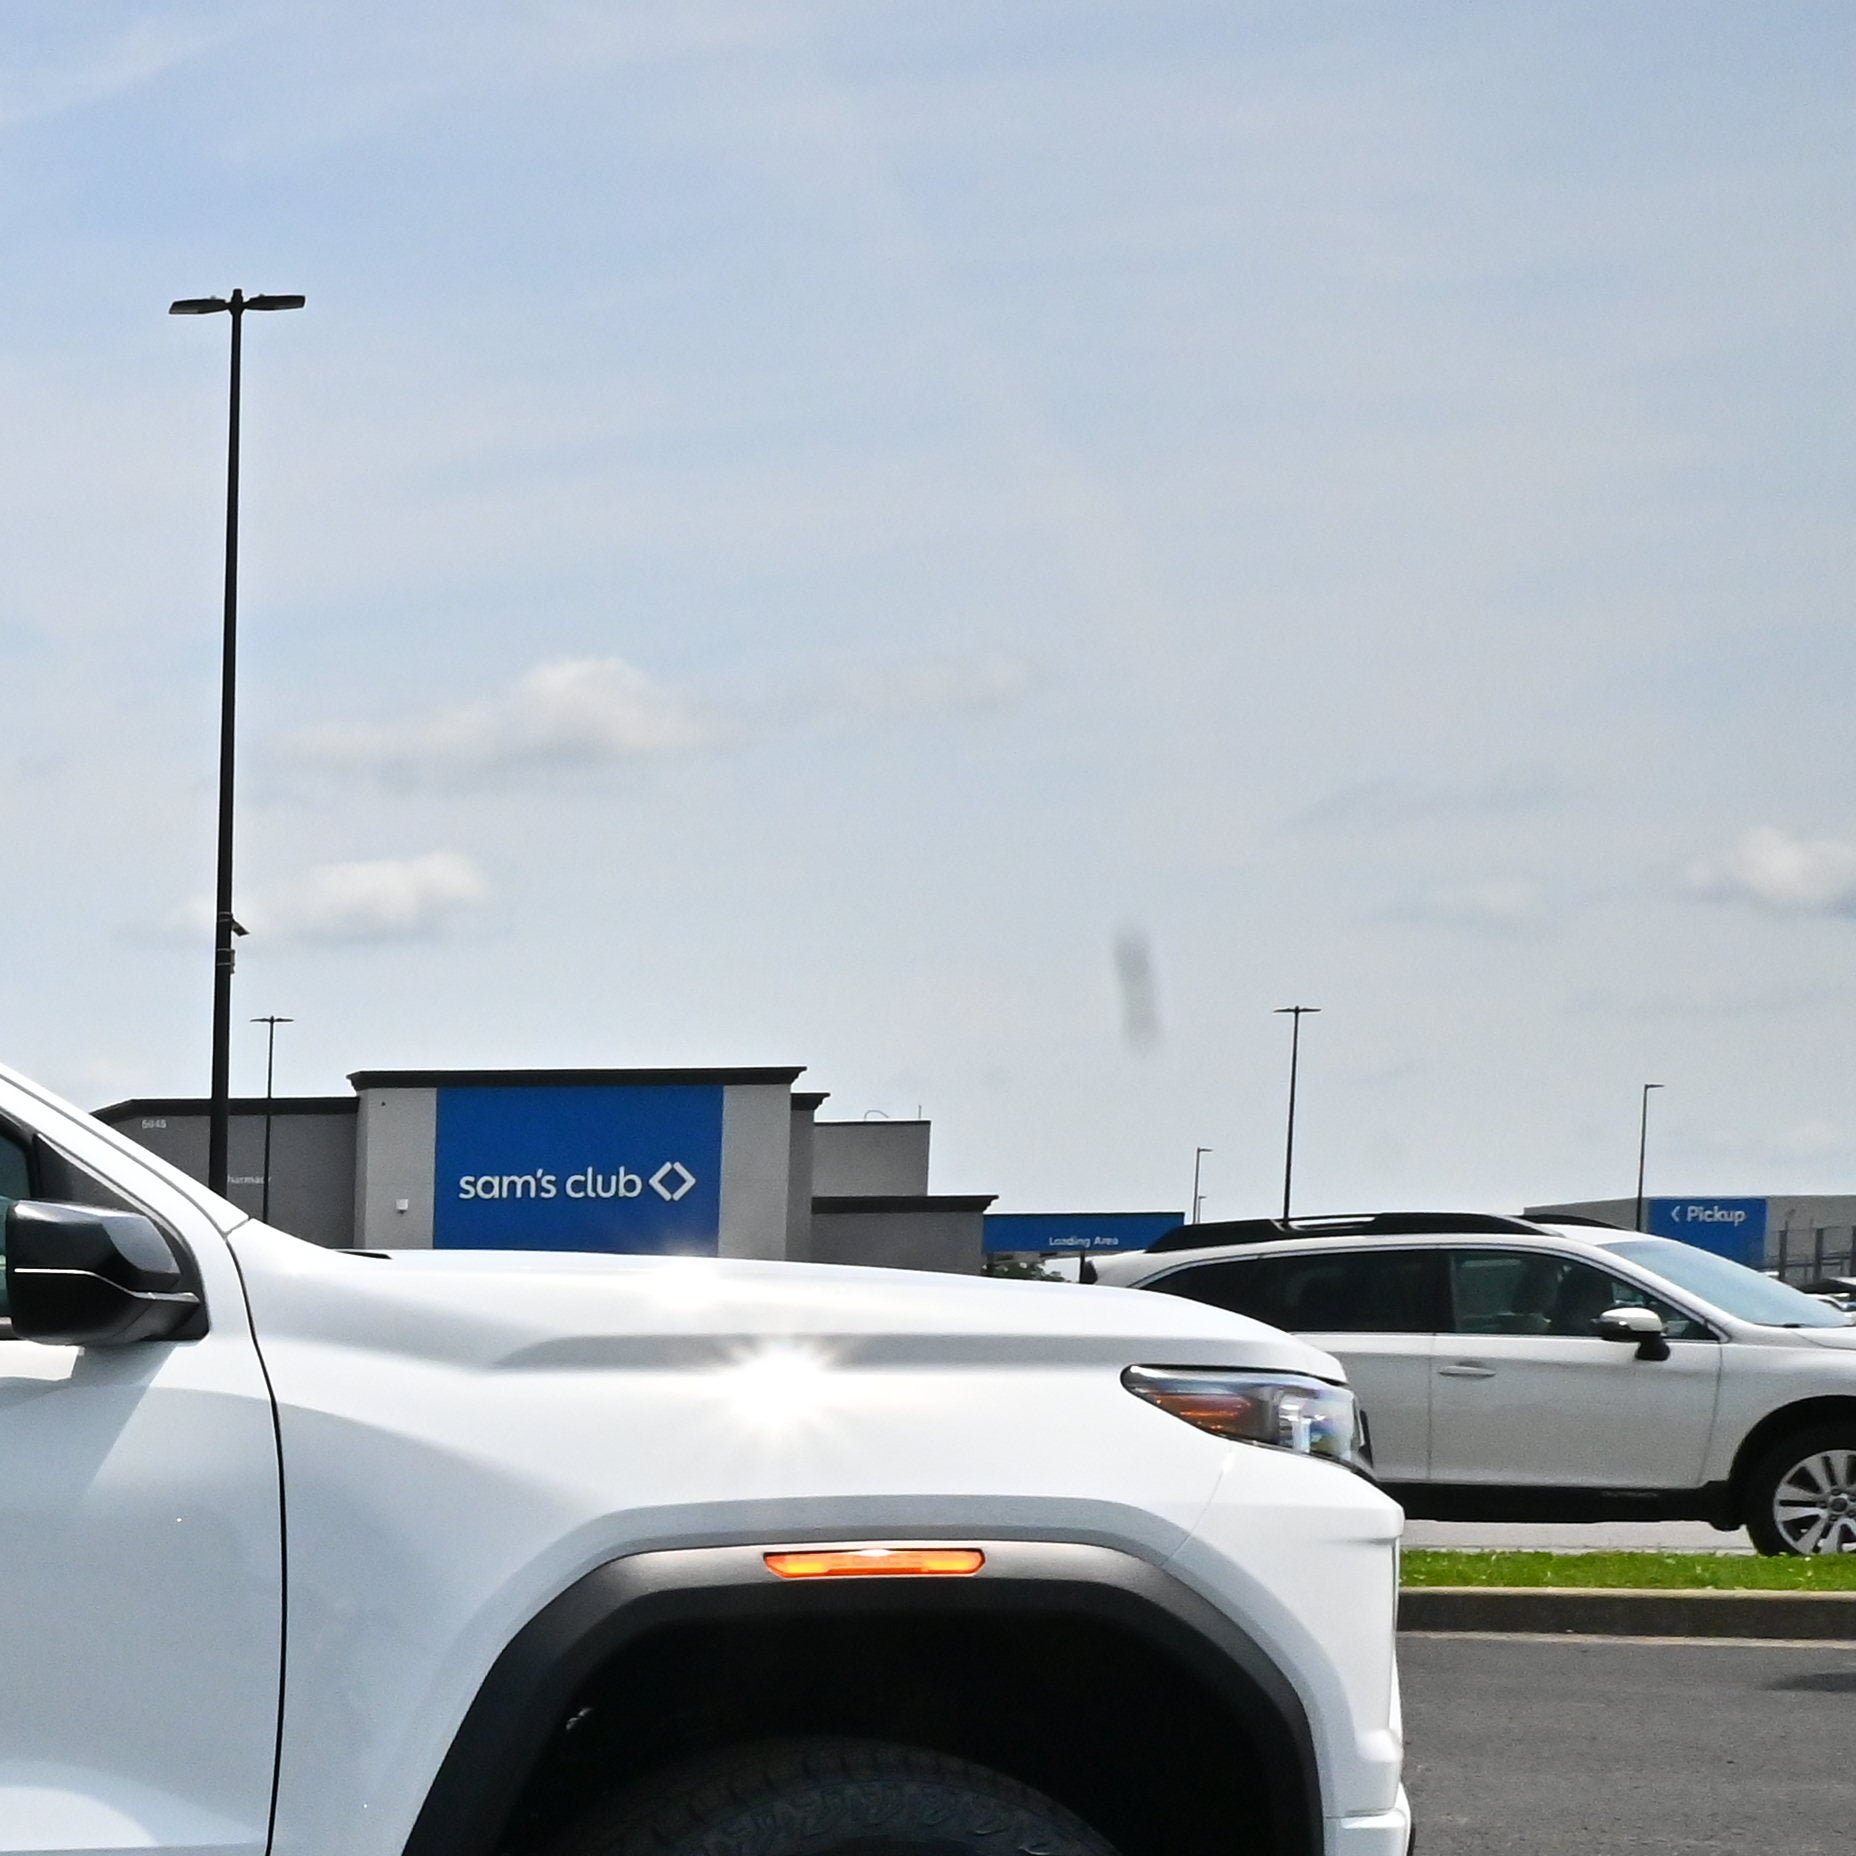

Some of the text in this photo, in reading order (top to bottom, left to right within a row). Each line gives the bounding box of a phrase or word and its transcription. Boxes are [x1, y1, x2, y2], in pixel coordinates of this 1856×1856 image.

[458, 1166, 642, 1199] sam's club
[1686, 1205, 1746, 1227] Pickup
[1048, 1235, 1119, 1248] Loading Area
